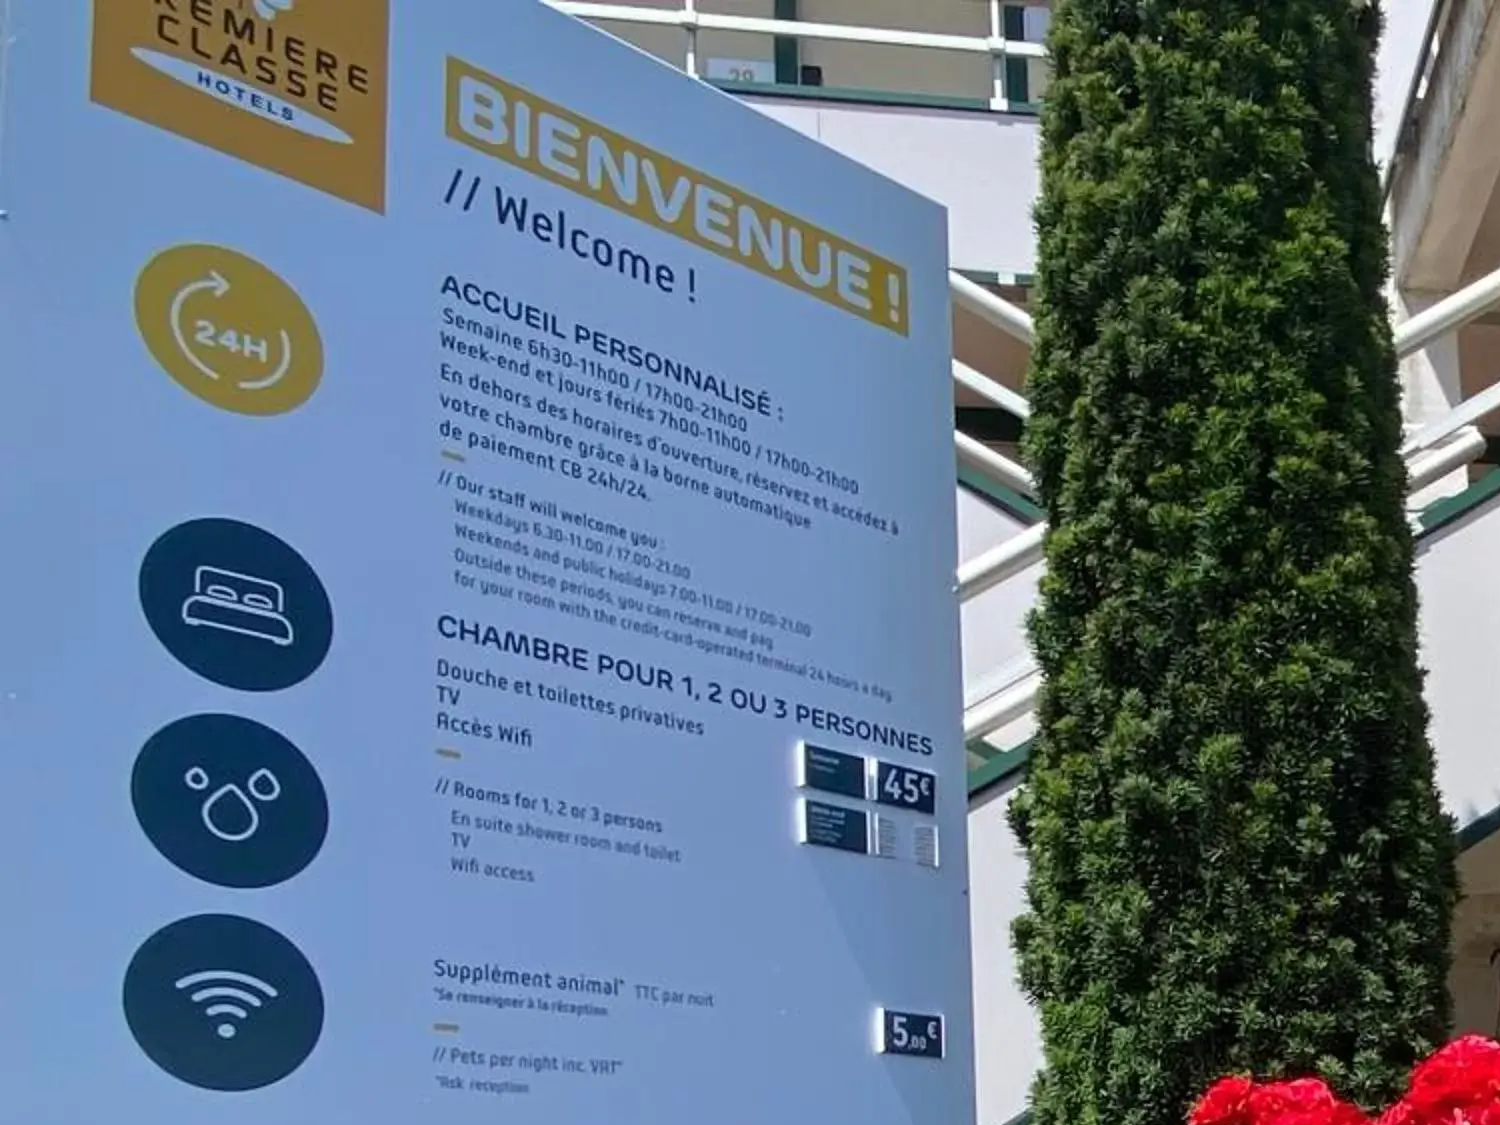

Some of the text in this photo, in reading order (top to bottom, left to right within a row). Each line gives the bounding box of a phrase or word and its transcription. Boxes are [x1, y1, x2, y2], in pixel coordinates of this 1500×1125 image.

[158, 15, 337, 111] CLASSE
[197, 71, 294, 121] HOTELS
[457, 74, 873, 312] BIENVENUE
[496, 186, 676, 295] Welcome
[194, 319, 267, 363] 24H
[441, 275, 771, 416] ACCUEIL PERSONNALISÉ
[443, 308, 747, 432] Semaine 6h30-11h00 17h00-21h00
[440, 331, 529, 377] Week-end
[536, 369, 553, 386] et
[558, 376, 602, 402] jours
[660, 409, 750, 456] 7h00-11h00
[766, 449, 859, 494] 17h00-21h00
[441, 363, 463, 385] En
[469, 374, 531, 408] dehors
[537, 397, 568, 421] des
[573, 408, 642, 446] horaires
[440, 420, 462, 440] de
[468, 431, 554, 472] paiement
[560, 458, 582, 480] CB
[440, 393, 489, 421] votre
[496, 410, 573, 450] chambre
[630, 454, 639, 471] à
[645, 460, 659, 478] la
[663, 466, 709, 495] borne
[714, 484, 811, 529] automatique
[455, 499, 529, 534] Weekdays
[456, 475, 626, 539] Our staff will welcome
[454, 548, 670, 620] Outside these you can
[455, 523, 667, 597] Weekends and public holidays
[454, 569, 617, 626] for your room with the
[437, 685, 460, 706] TV
[437, 659, 704, 735] Douche et toilettes privatives
[438, 614, 933, 756] CHAMBRE POUR 1, 2 OU 3 PERSONNES
[437, 712, 532, 747] Accès Wifi
[451, 810, 641, 856] En suite shower room and
[454, 781, 663, 832] Rooms for persons
[451, 832, 471, 848] TV
[451, 857, 535, 882] Wifi access
[434, 959, 552, 989] Supplément
[662, 989, 684, 1007] par
[450, 1048, 559, 1073] Pets per night
